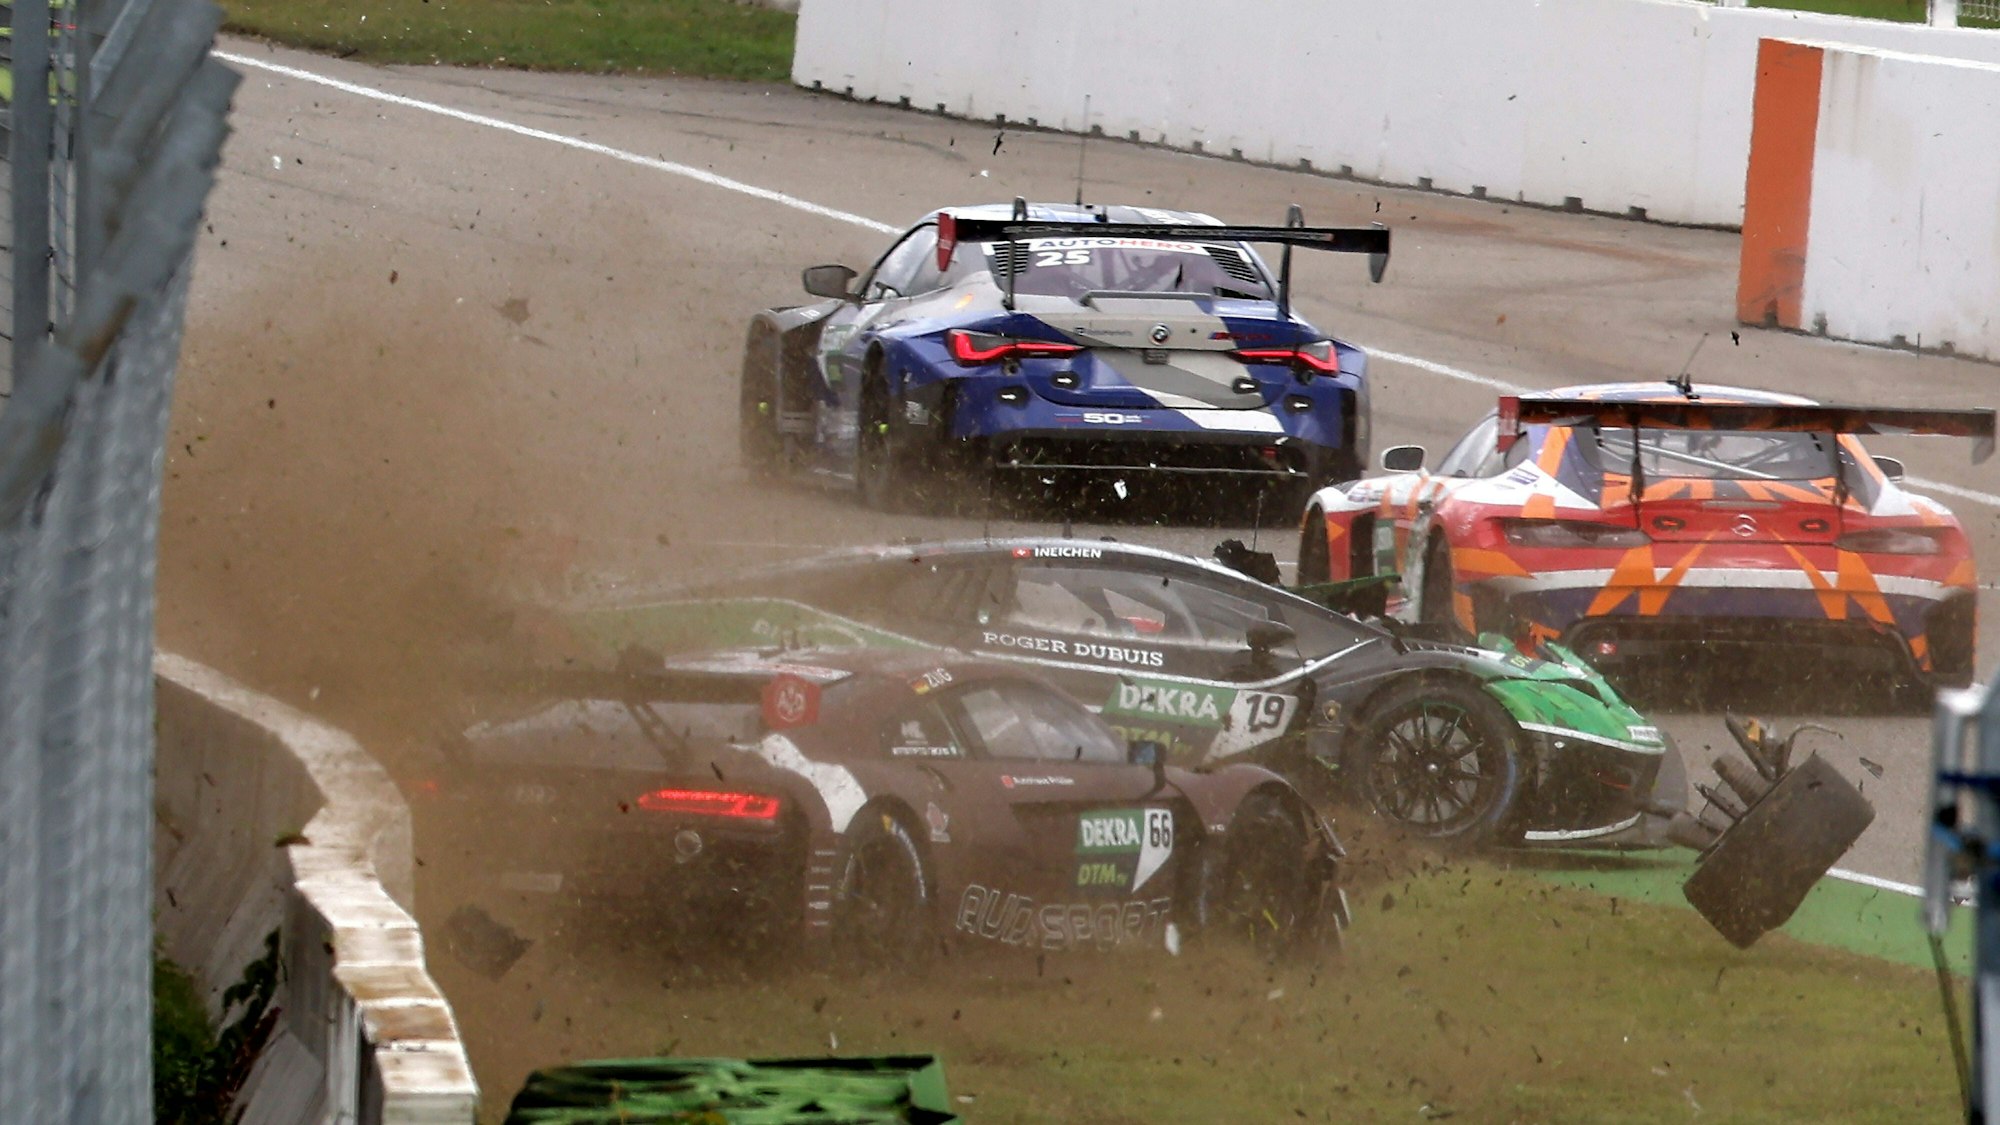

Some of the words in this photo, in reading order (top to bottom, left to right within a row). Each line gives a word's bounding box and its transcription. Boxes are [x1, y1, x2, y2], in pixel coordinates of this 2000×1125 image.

[1039, 237, 1197, 252] AUTOHERO
[1035, 250, 1091, 267] 25
[1083, 413, 1124, 424] 50
[1034, 547, 1102, 558] INEICHEN
[983, 632, 1068, 654] ROGER
[1074, 643, 1164, 667] DUBUIS
[923, 668, 953, 688] ZUG
[1119, 682, 1219, 720] DEKRA
[1245, 693, 1286, 733] 19
[1081, 818, 1141, 847] DEKRA
[1150, 812, 1171, 848] 66
[956, 884, 1036, 947] AUD
